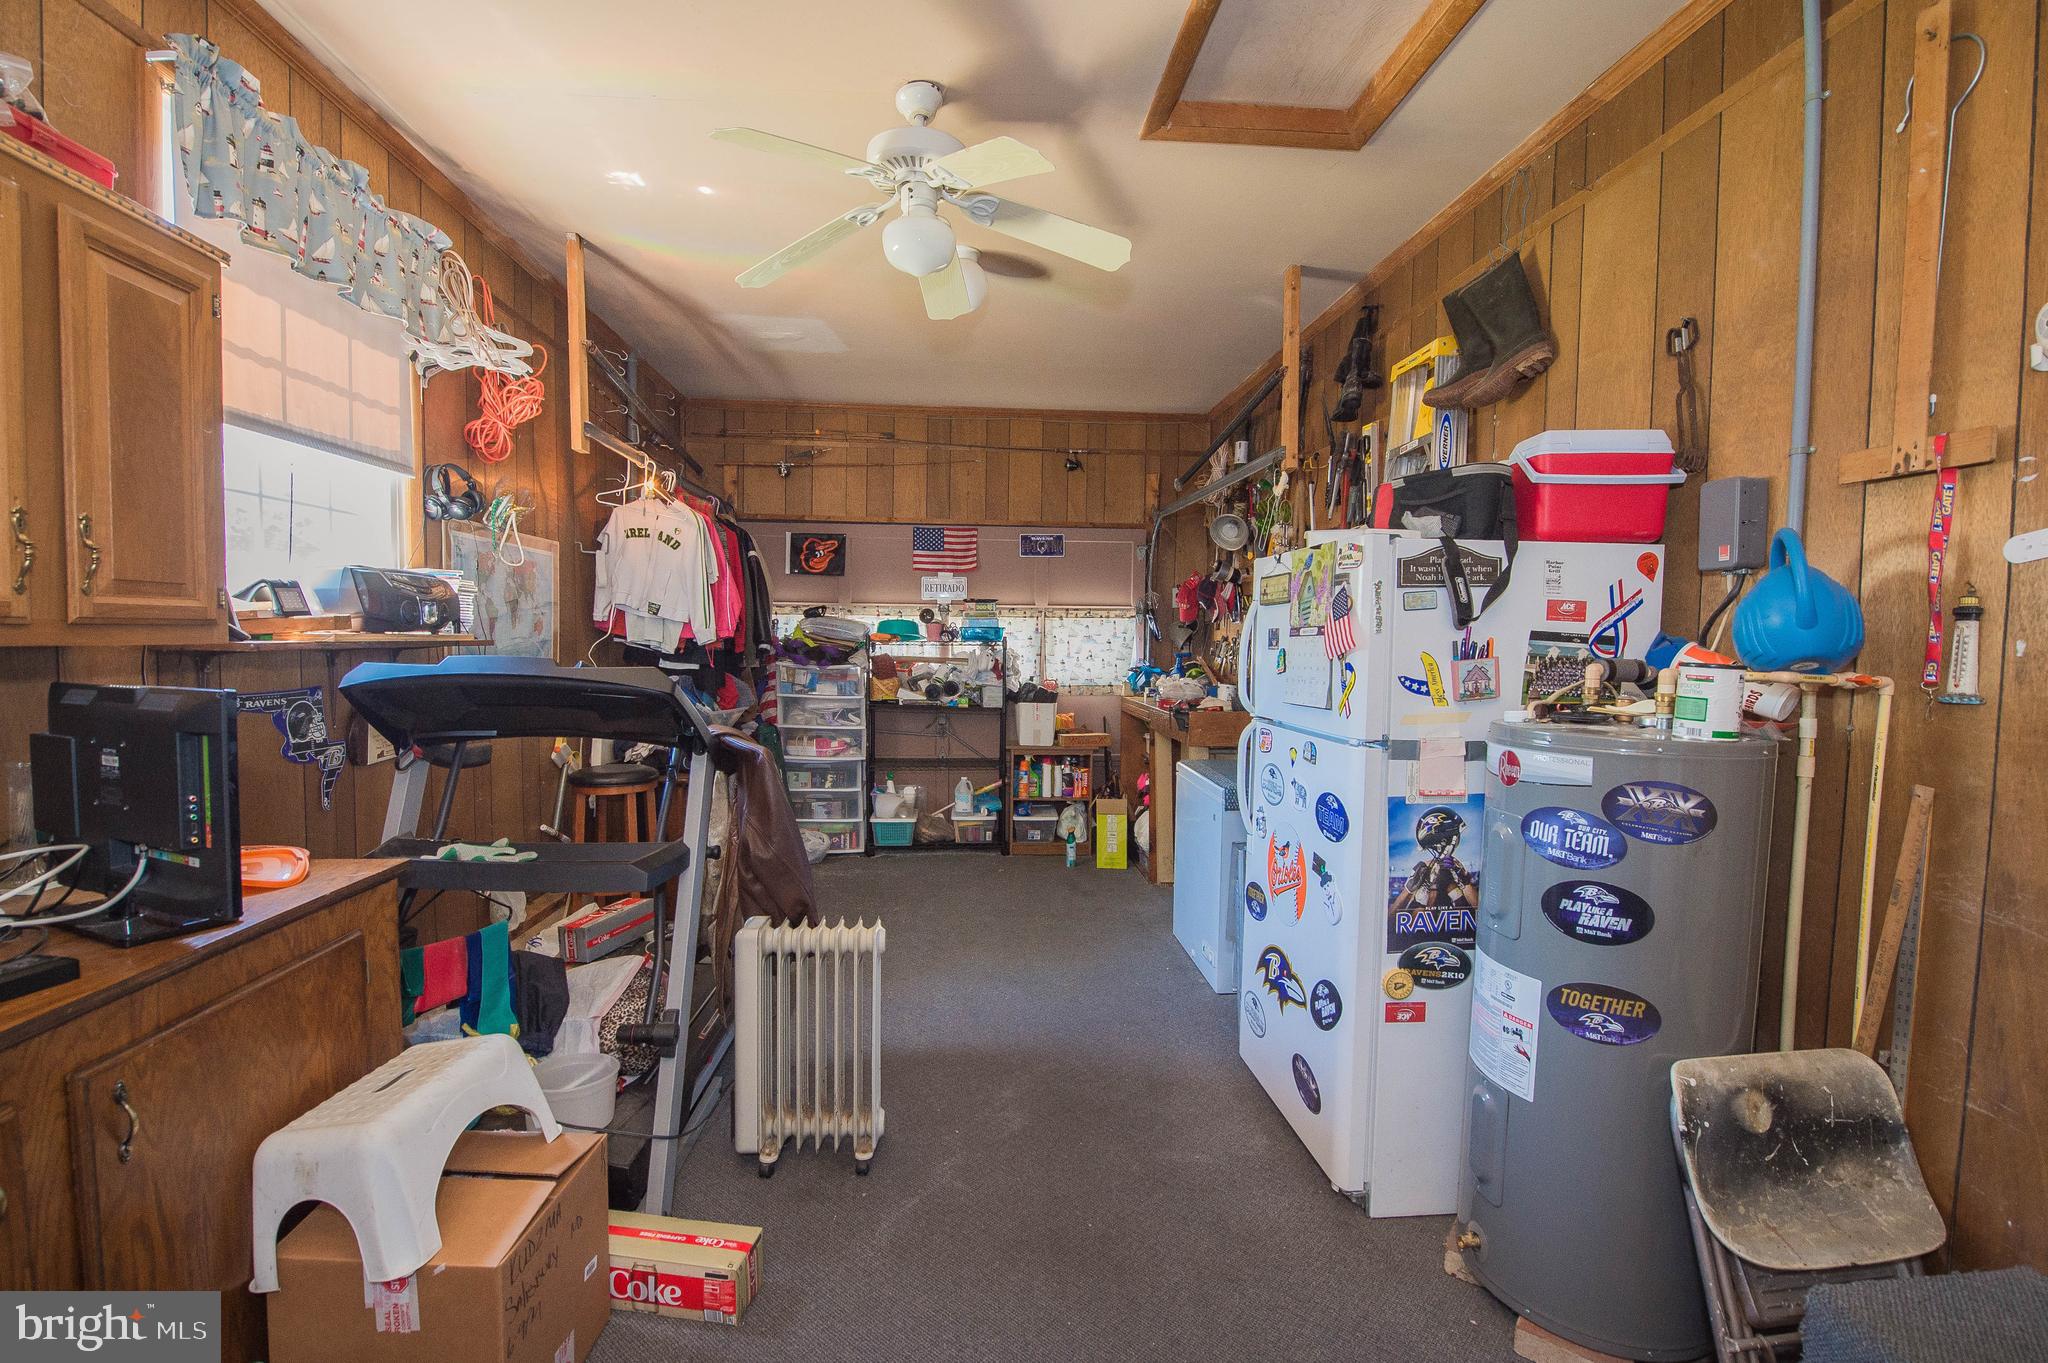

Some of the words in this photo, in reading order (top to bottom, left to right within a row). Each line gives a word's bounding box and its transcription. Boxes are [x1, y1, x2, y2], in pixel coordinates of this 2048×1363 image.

[1942, 484, 1955, 515] GATE1
[1930, 551, 1941, 583] GATE1
[1415, 573, 1437, 581] Noah
[924, 583, 965, 593] RETIRADO
[1560, 602, 1577, 610] ACE
[245, 697, 288, 709] RAVENS
[1533, 754, 1589, 766] PROFESSIONAL
[1529, 819, 1559, 845] OUR
[1564, 828, 1613, 858] TEAM.
[1271, 858, 1302, 887] Orioles
[1559, 898, 1589, 913] PLAY
[1587, 905, 1606, 916] LIKE
[1605, 908, 1614, 917] A
[1578, 913, 1633, 932] RAVEN
[1560, 988, 1647, 1018] TOGETHER
[1396, 1012, 1413, 1021] ACE
[1508, 1014, 1533, 1029] DANGER
[656, 1232, 687, 1241] CAFFEINE
[695, 1236, 725, 1248] Coke
[609, 1269, 682, 1306] Coke
